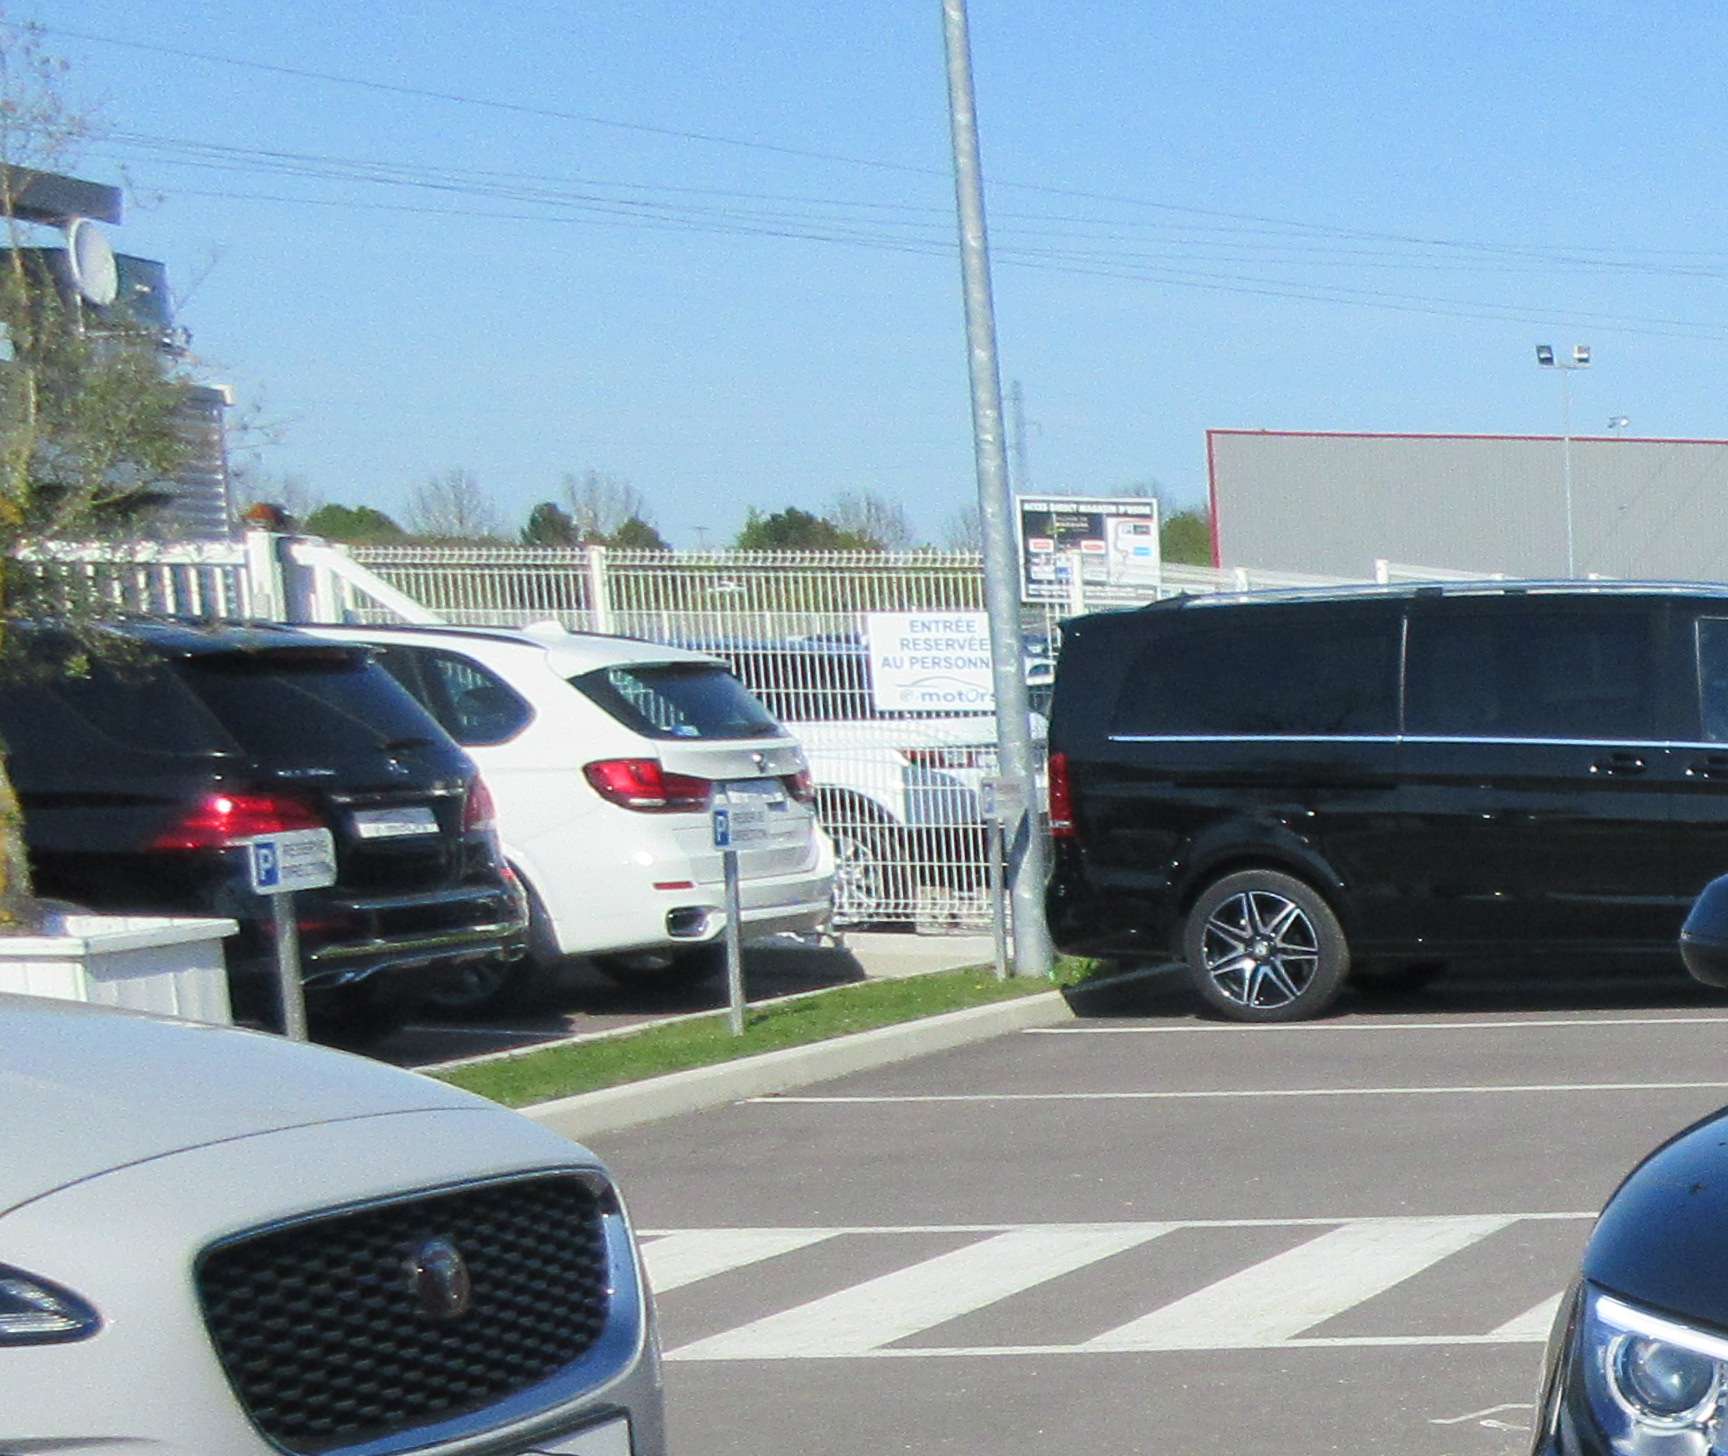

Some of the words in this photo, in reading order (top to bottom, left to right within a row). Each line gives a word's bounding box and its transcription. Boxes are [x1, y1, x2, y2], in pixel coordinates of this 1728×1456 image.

[909, 616, 976, 634] ENTRÉE
[900, 636, 989, 651] RESERVÉE
[881, 656, 904, 669] AU
[910, 656, 990, 670] PERSONN
[258, 849, 274, 881] P
